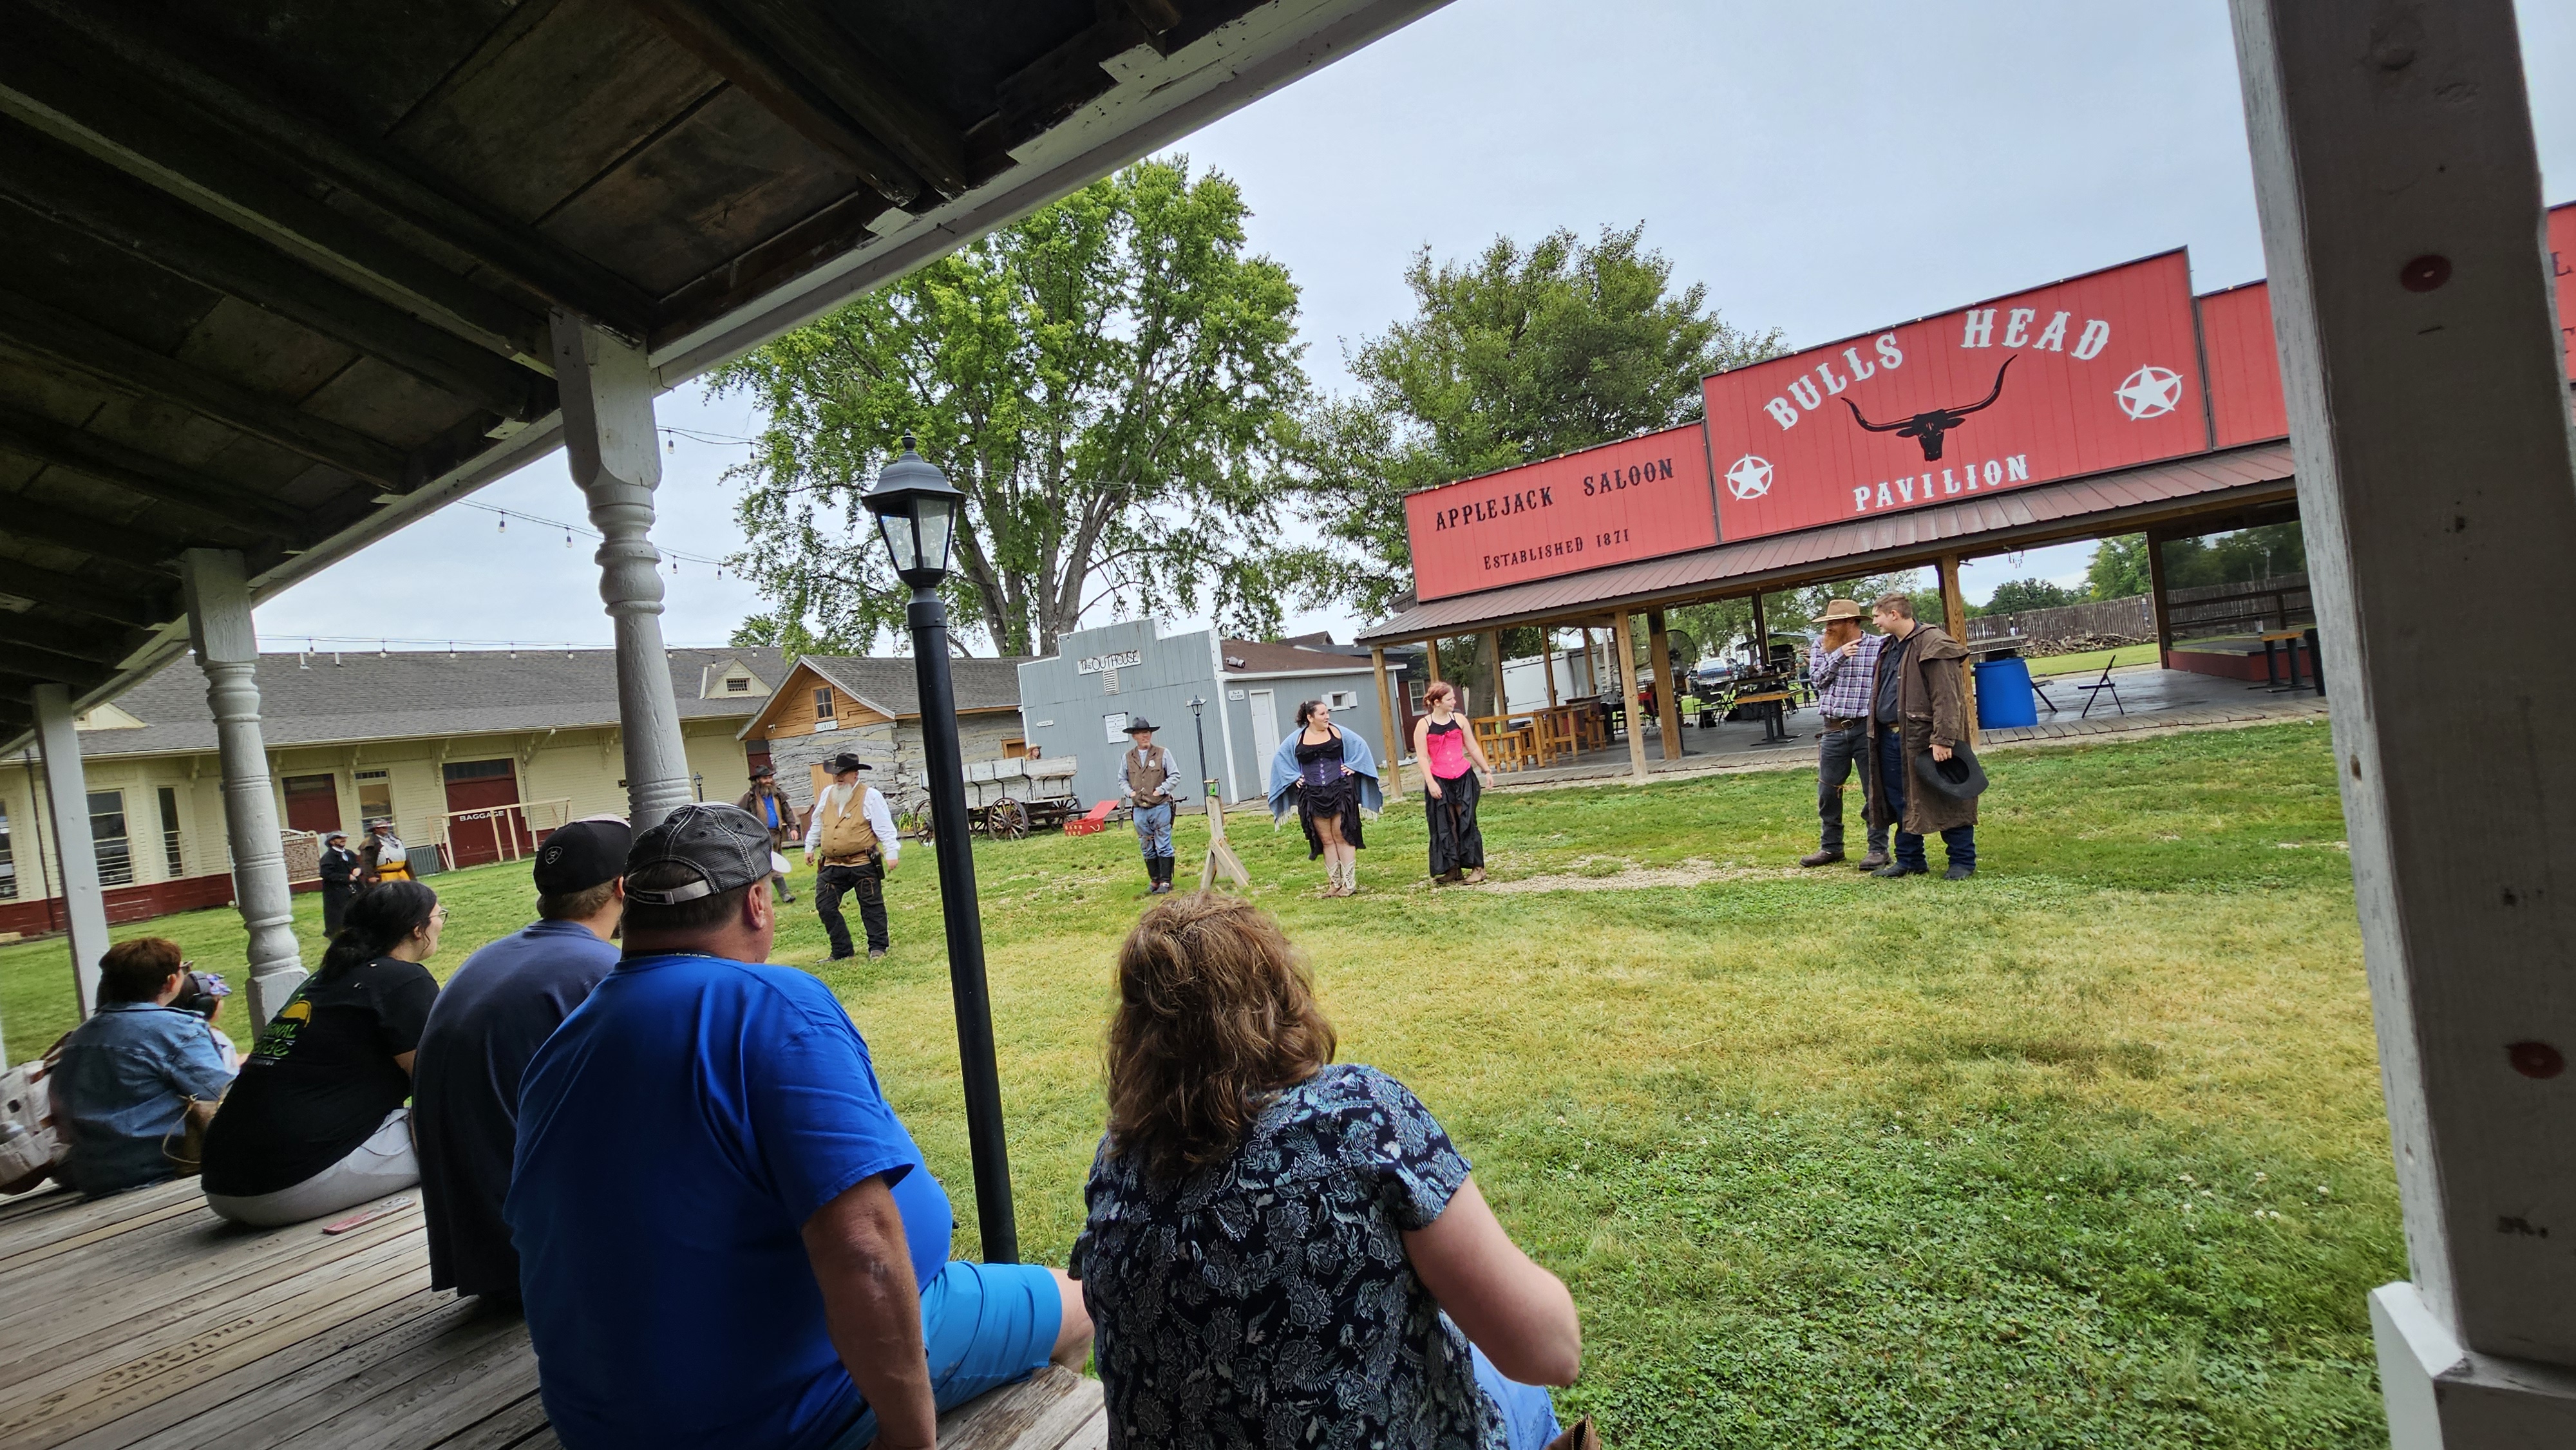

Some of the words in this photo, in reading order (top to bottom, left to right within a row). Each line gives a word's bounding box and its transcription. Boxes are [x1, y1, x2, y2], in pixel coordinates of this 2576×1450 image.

[1764, 331, 1904, 431] BULLS
[1960, 308, 2110, 361] HEAD
[1435, 486, 1554, 532] APPLEJACK
[1583, 458, 1674, 497] SALOON
[1854, 454, 2030, 512] PAVILION
[1596, 529, 1631, 549] 1871
[1092, 650, 1139, 671] OUTHOUSE
[459, 810, 505, 822] BAGGAGE
[102, 1319, 254, 1383] DILLARD
